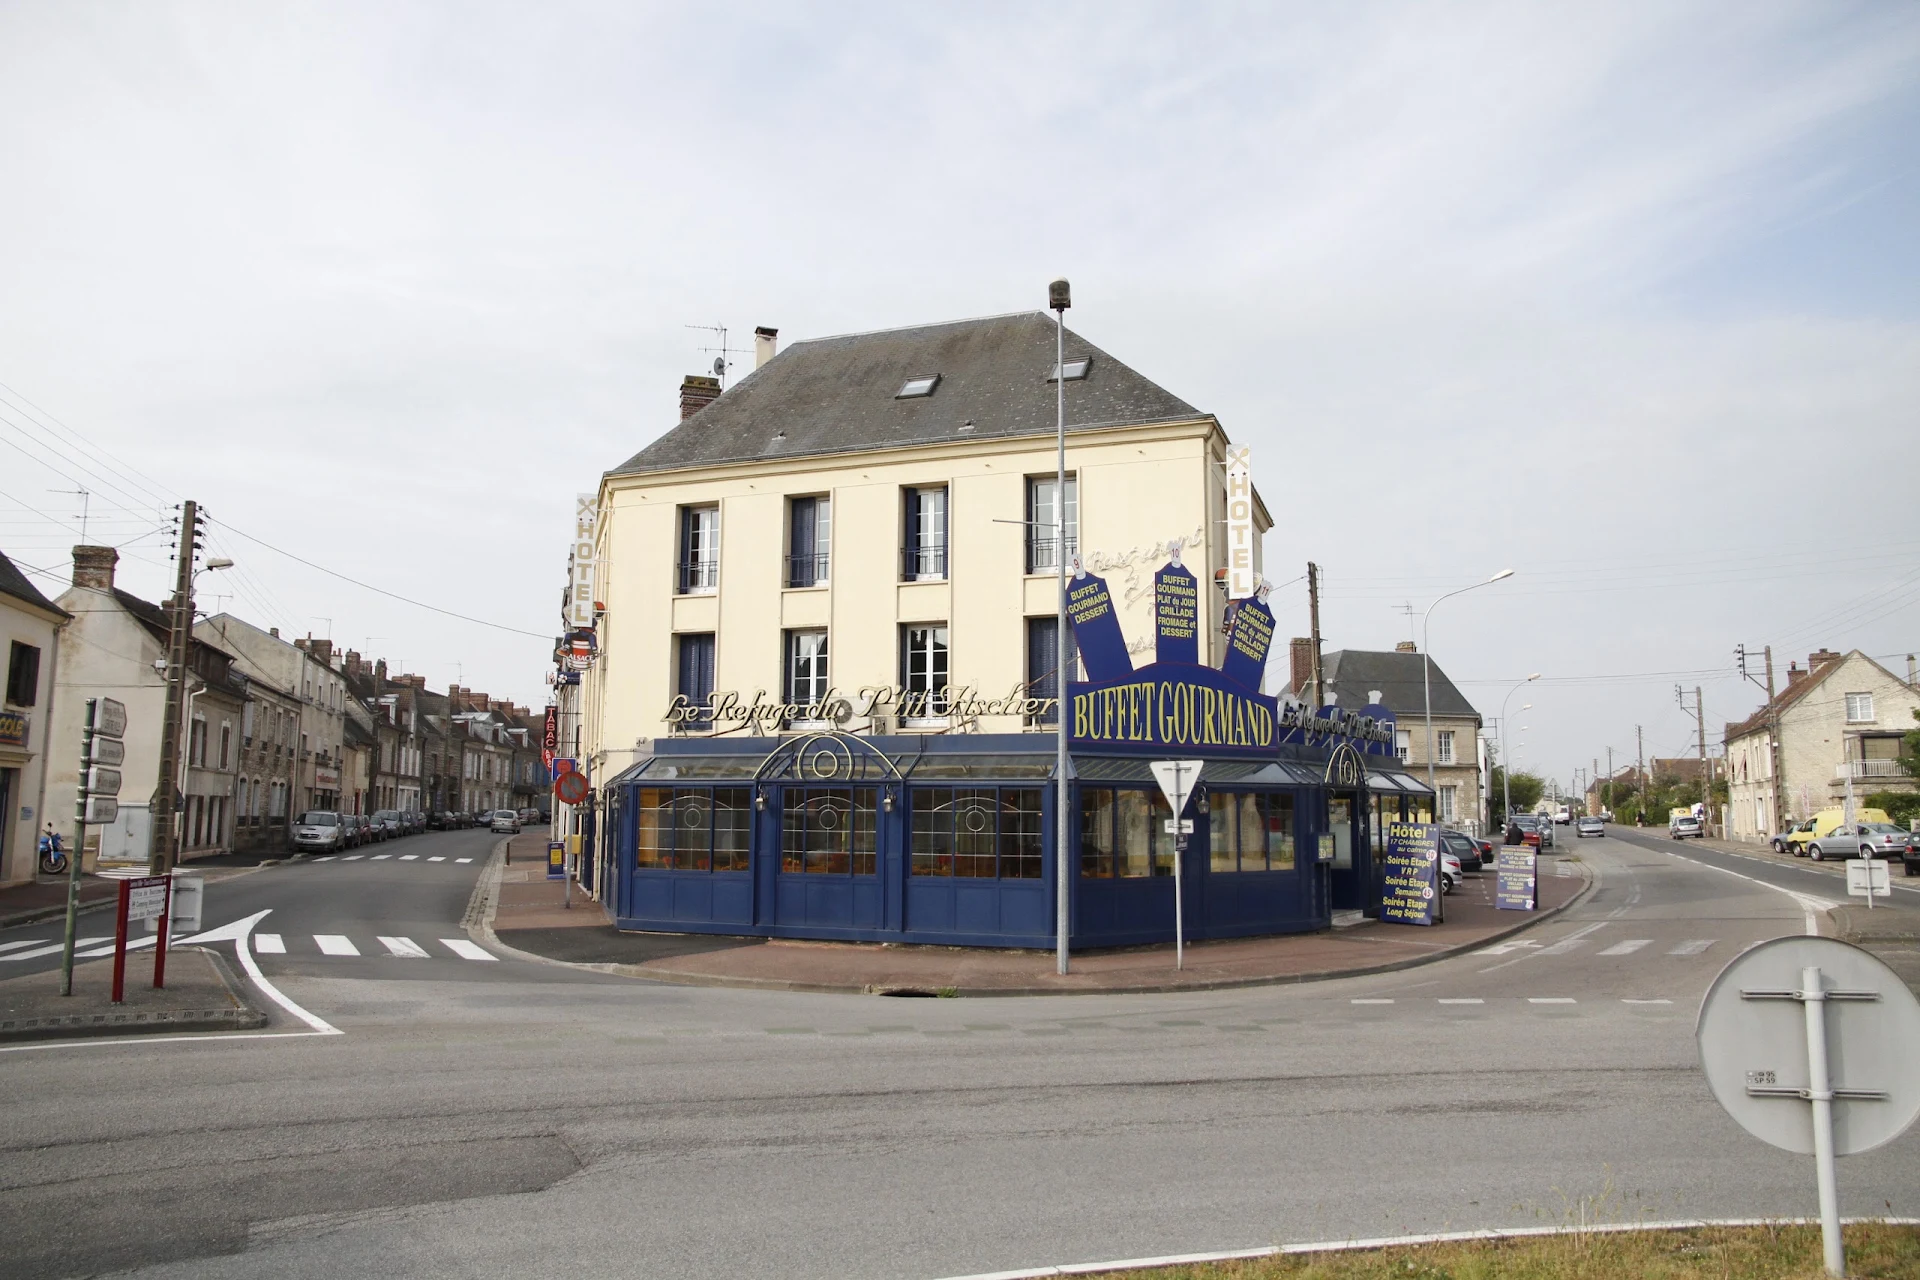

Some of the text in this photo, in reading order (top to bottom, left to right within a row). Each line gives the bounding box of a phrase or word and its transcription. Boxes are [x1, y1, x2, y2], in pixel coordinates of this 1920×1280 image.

[1229, 476, 1250, 594] HOTEL
[1171, 548, 1180, 559] 10
[1073, 558, 1080, 570] 9
[574, 521, 594, 622] HOTEL
[1162, 574, 1190, 587] BUFFET
[1070, 583, 1099, 601] BUFFET
[1157, 584, 1196, 597] GOURMAND
[1261, 586, 1269, 597] 11
[1067, 591, 1109, 614] GOURMAND
[1157, 595, 1196, 608] PLAT du JOUR
[1074, 603, 1109, 625] DESSERT
[1159, 606, 1194, 618] GRILLADE
[1245, 603, 1269, 623] BUFFET
[1158, 616, 1196, 629] FROMAGE et
[1237, 609, 1272, 636] GOURMAND
[1160, 627, 1193, 639] DESSERT
[1235, 619, 1269, 645] PLAT du JOUR
[1235, 629, 1266, 654] GRILLADE
[568, 653, 594, 661] ALSACE
[1233, 639, 1262, 662] DESSERT
[660, 694, 698, 723] Le
[702, 689, 801, 731] Refuge
[805, 687, 841, 720] du
[931, 682, 1060, 718] Fischer
[1073, 681, 1273, 747] BUFFET GOURMAND
[546, 707, 556, 747] TABAC
[1390, 825, 1427, 839] Hôtel
[1398, 838, 1435, 847] CHAMBRES
[1407, 846, 1427, 854] calme
[1387, 855, 1431, 869] Soirée Etape
[1385, 876, 1429, 889] Soirée Etape
[1395, 887, 1421, 897] Semaine
[1383, 896, 1428, 909] Soirée Etape
[1386, 907, 1425, 918] Long Séjour
